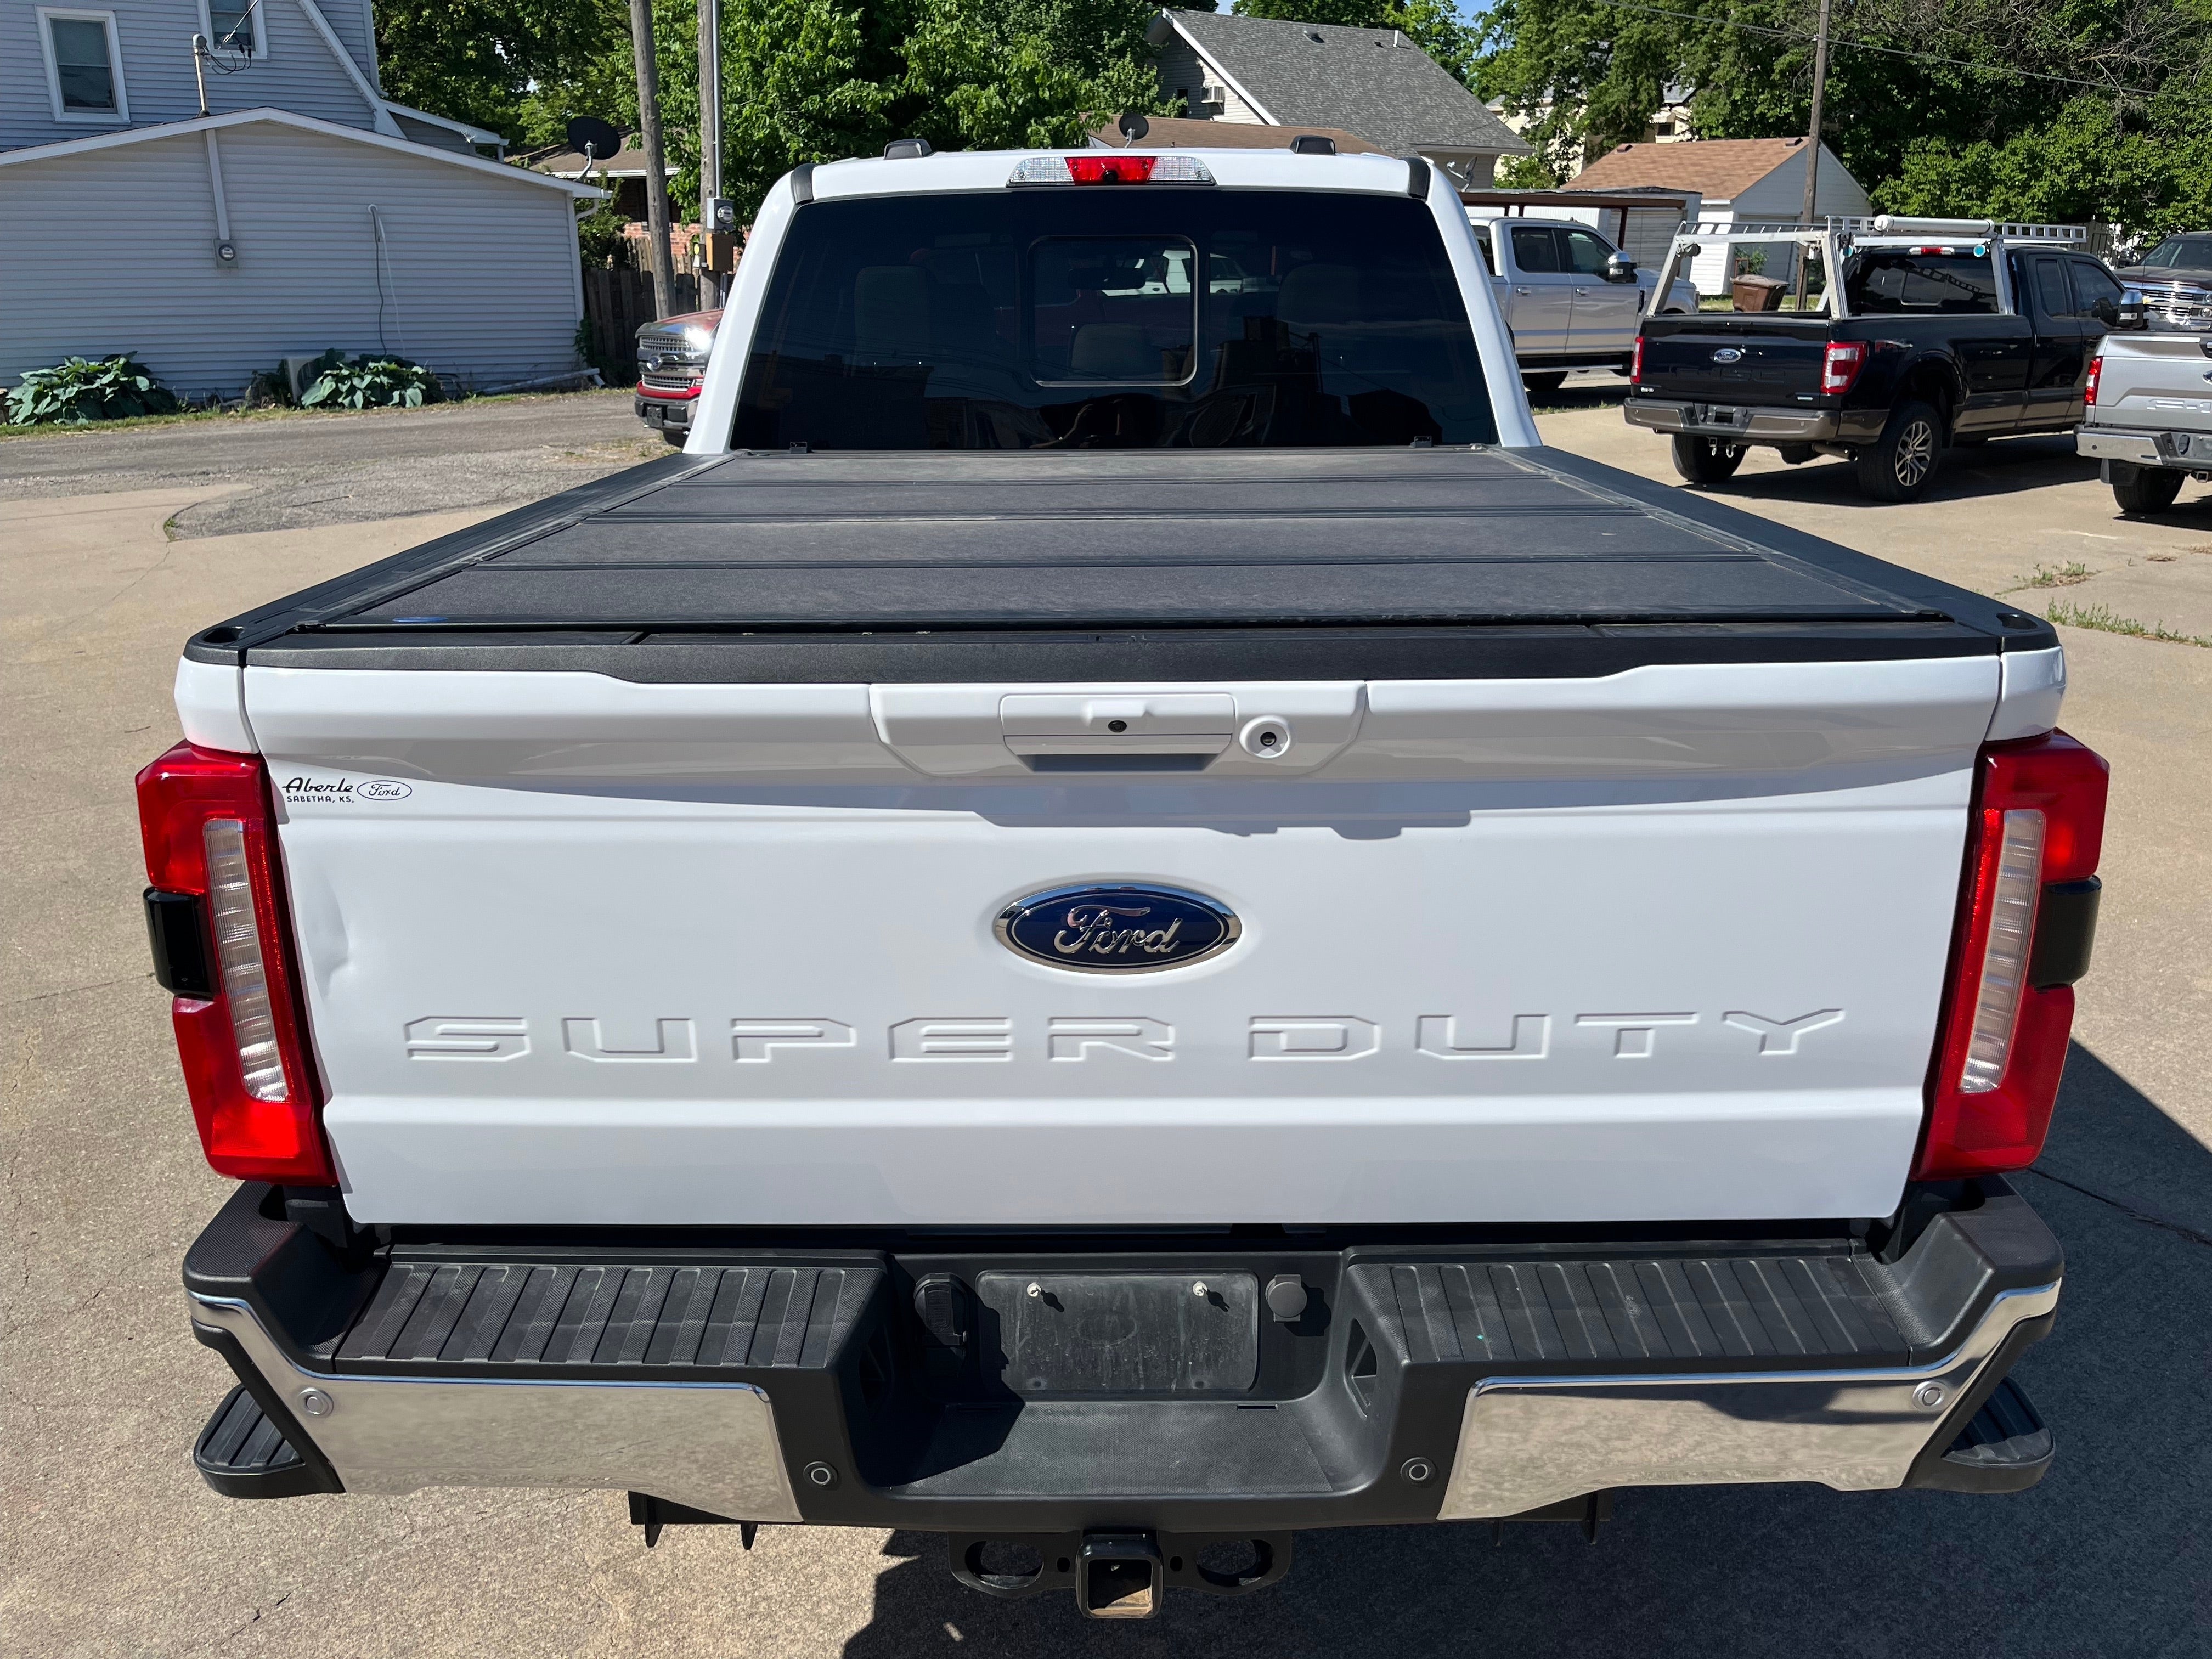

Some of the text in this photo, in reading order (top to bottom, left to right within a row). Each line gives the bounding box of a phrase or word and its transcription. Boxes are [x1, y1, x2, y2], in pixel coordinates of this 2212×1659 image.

[281, 777, 354, 793] Aberle
[368, 783, 401, 797] Ford
[1053, 904, 1183, 954] Ford
[403, 1008, 1846, 1063] SUPER DUTY
